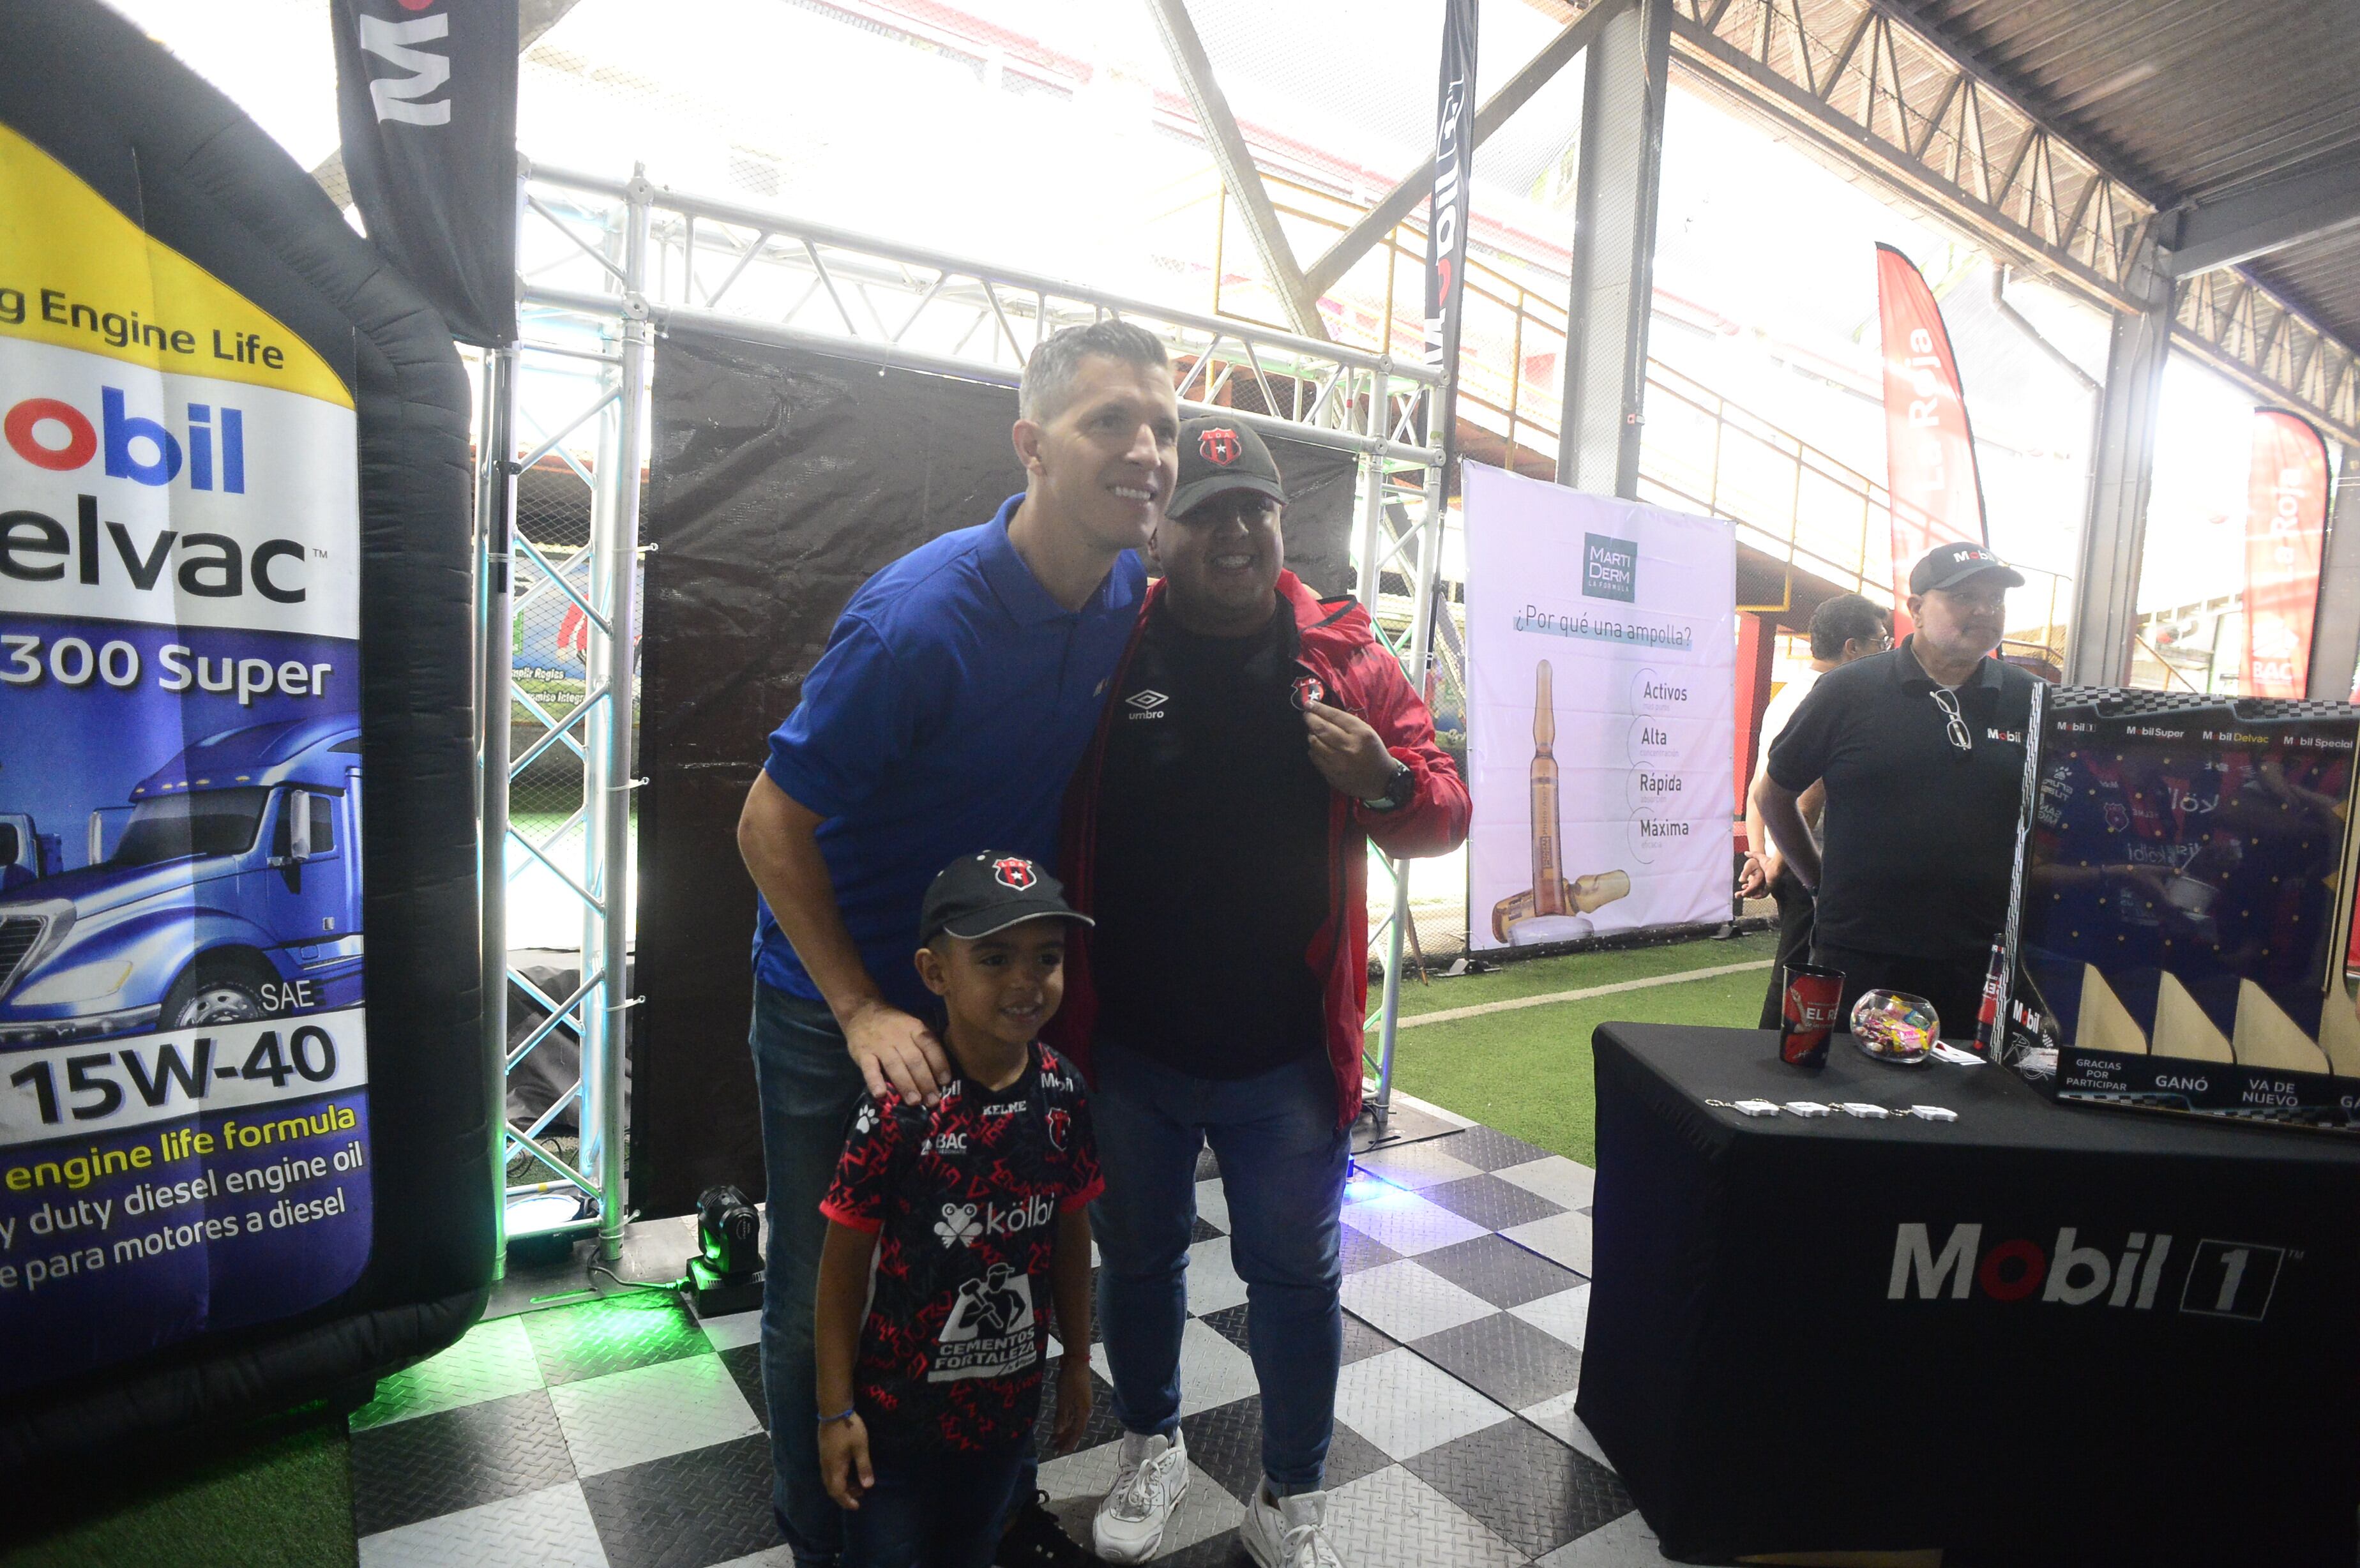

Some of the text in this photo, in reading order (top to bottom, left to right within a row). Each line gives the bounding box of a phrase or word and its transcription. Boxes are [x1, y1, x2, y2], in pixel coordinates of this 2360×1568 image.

[41, 288, 195, 354] Engine
[213, 329, 284, 369] Life
[0, 494, 306, 603] elvac
[1590, 546, 1630, 567] MARTI
[1589, 562, 1630, 584] DERM
[1516, 605, 1691, 647] ¿Por qué una ampolla?
[0, 635, 331, 705] 300 Super
[2253, 661, 2292, 679] BAC
[1644, 681, 1687, 701] Activos
[1129, 710, 1164, 720] umbro
[1642, 727, 1667, 744] Alta
[1987, 728, 2021, 743] Mobil
[2057, 721, 2085, 731] Mobil
[2126, 726, 2184, 739] Mobil Super
[2234, 733, 2269, 743] Delvac
[2315, 738, 2353, 748] Special
[1640, 773, 1682, 795] Rápida
[1640, 818, 1689, 837] Máxima
[261, 980, 314, 1011] SAE
[1806, 1007, 1824, 1020] EL
[2013, 999, 2040, 1034] Mobil
[2076, 1059, 2121, 1071] GRACIAS
[2086, 1069, 2108, 1079] POR
[11, 1026, 337, 1124] 15W-40
[2066, 1078, 2127, 1091] PARTICIPAR
[2156, 1076, 2208, 1092] GANÓ
[2249, 1079, 2294, 1093] VA DE
[983, 1101, 1027, 1115] KELME
[2243, 1091, 2297, 1106] NUEVO
[5, 1104, 356, 1190] engine life formula
[936, 1133, 967, 1149] BAC
[30, 1199, 112, 1234] duty
[125, 1170, 217, 1214] diesel
[226, 1154, 327, 1193] engine
[333, 1141, 363, 1172] oil
[987, 1192, 1055, 1235] kölbi
[26, 1246, 105, 1291] para
[114, 1216, 239, 1264] motores
[247, 1212, 262, 1233] a
[269, 1187, 345, 1229] diesel
[1887, 1223, 2172, 1310] Mobil
[940, 1327, 1035, 1356] CEMENTOS
[935, 1341, 1034, 1369] FORTALEZA
